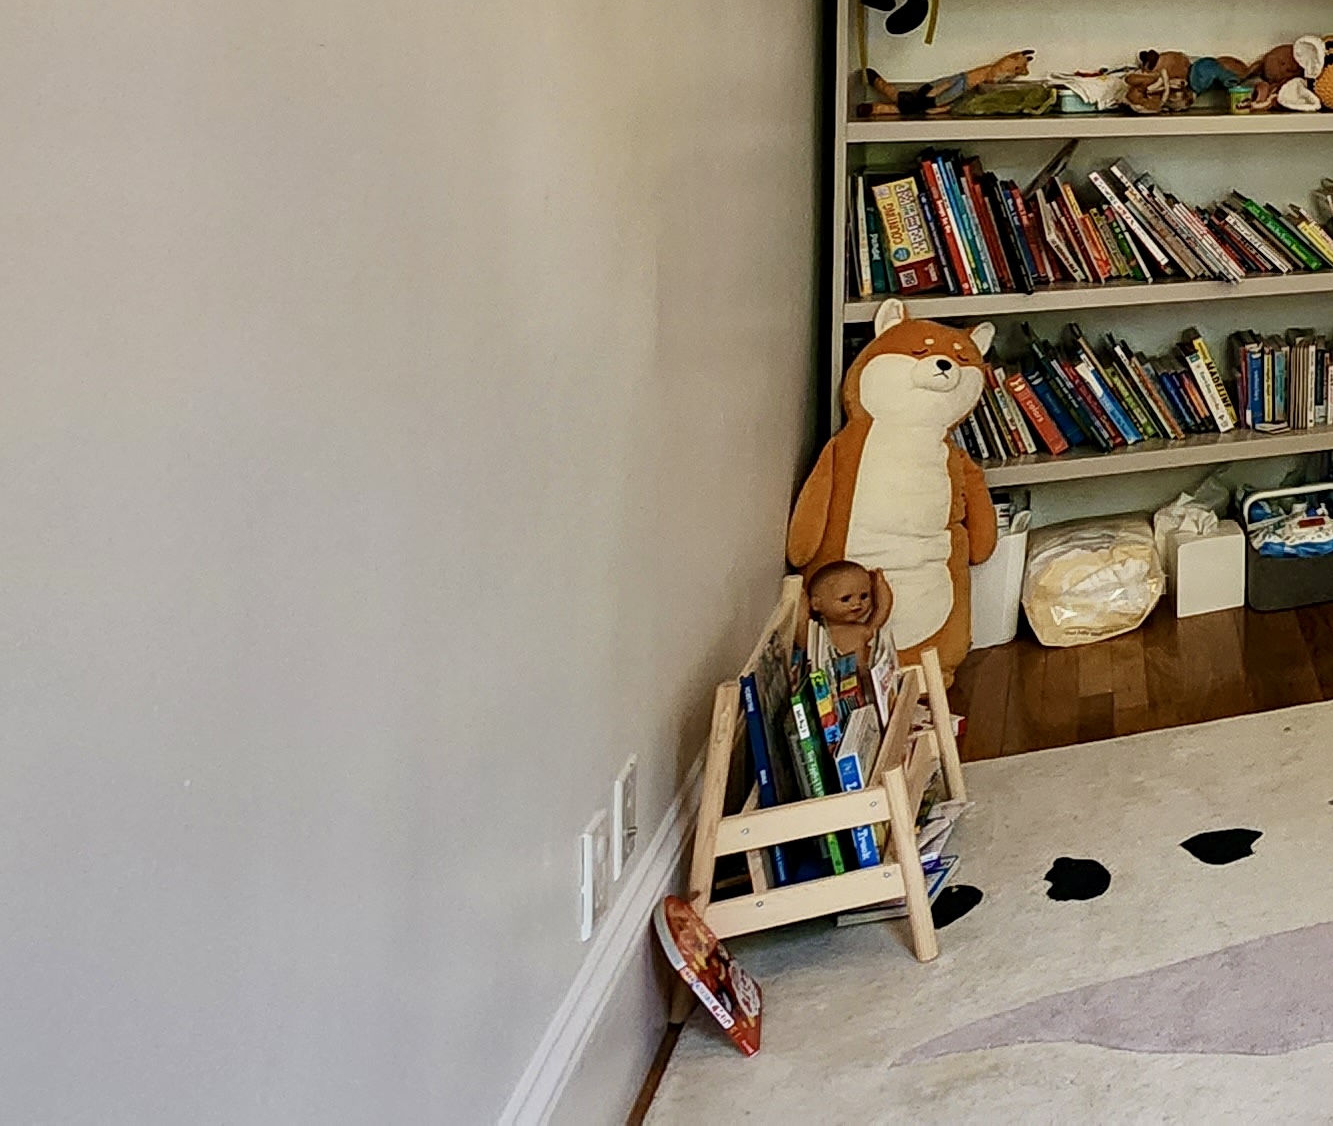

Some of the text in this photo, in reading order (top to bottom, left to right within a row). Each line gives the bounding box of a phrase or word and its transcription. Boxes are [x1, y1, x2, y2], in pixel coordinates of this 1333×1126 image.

[882, 202, 904, 246] COUNTING
[1204, 360, 1232, 409] MADELINE
[1025, 397, 1046, 424] colors
[855, 828, 874, 861] Truck
